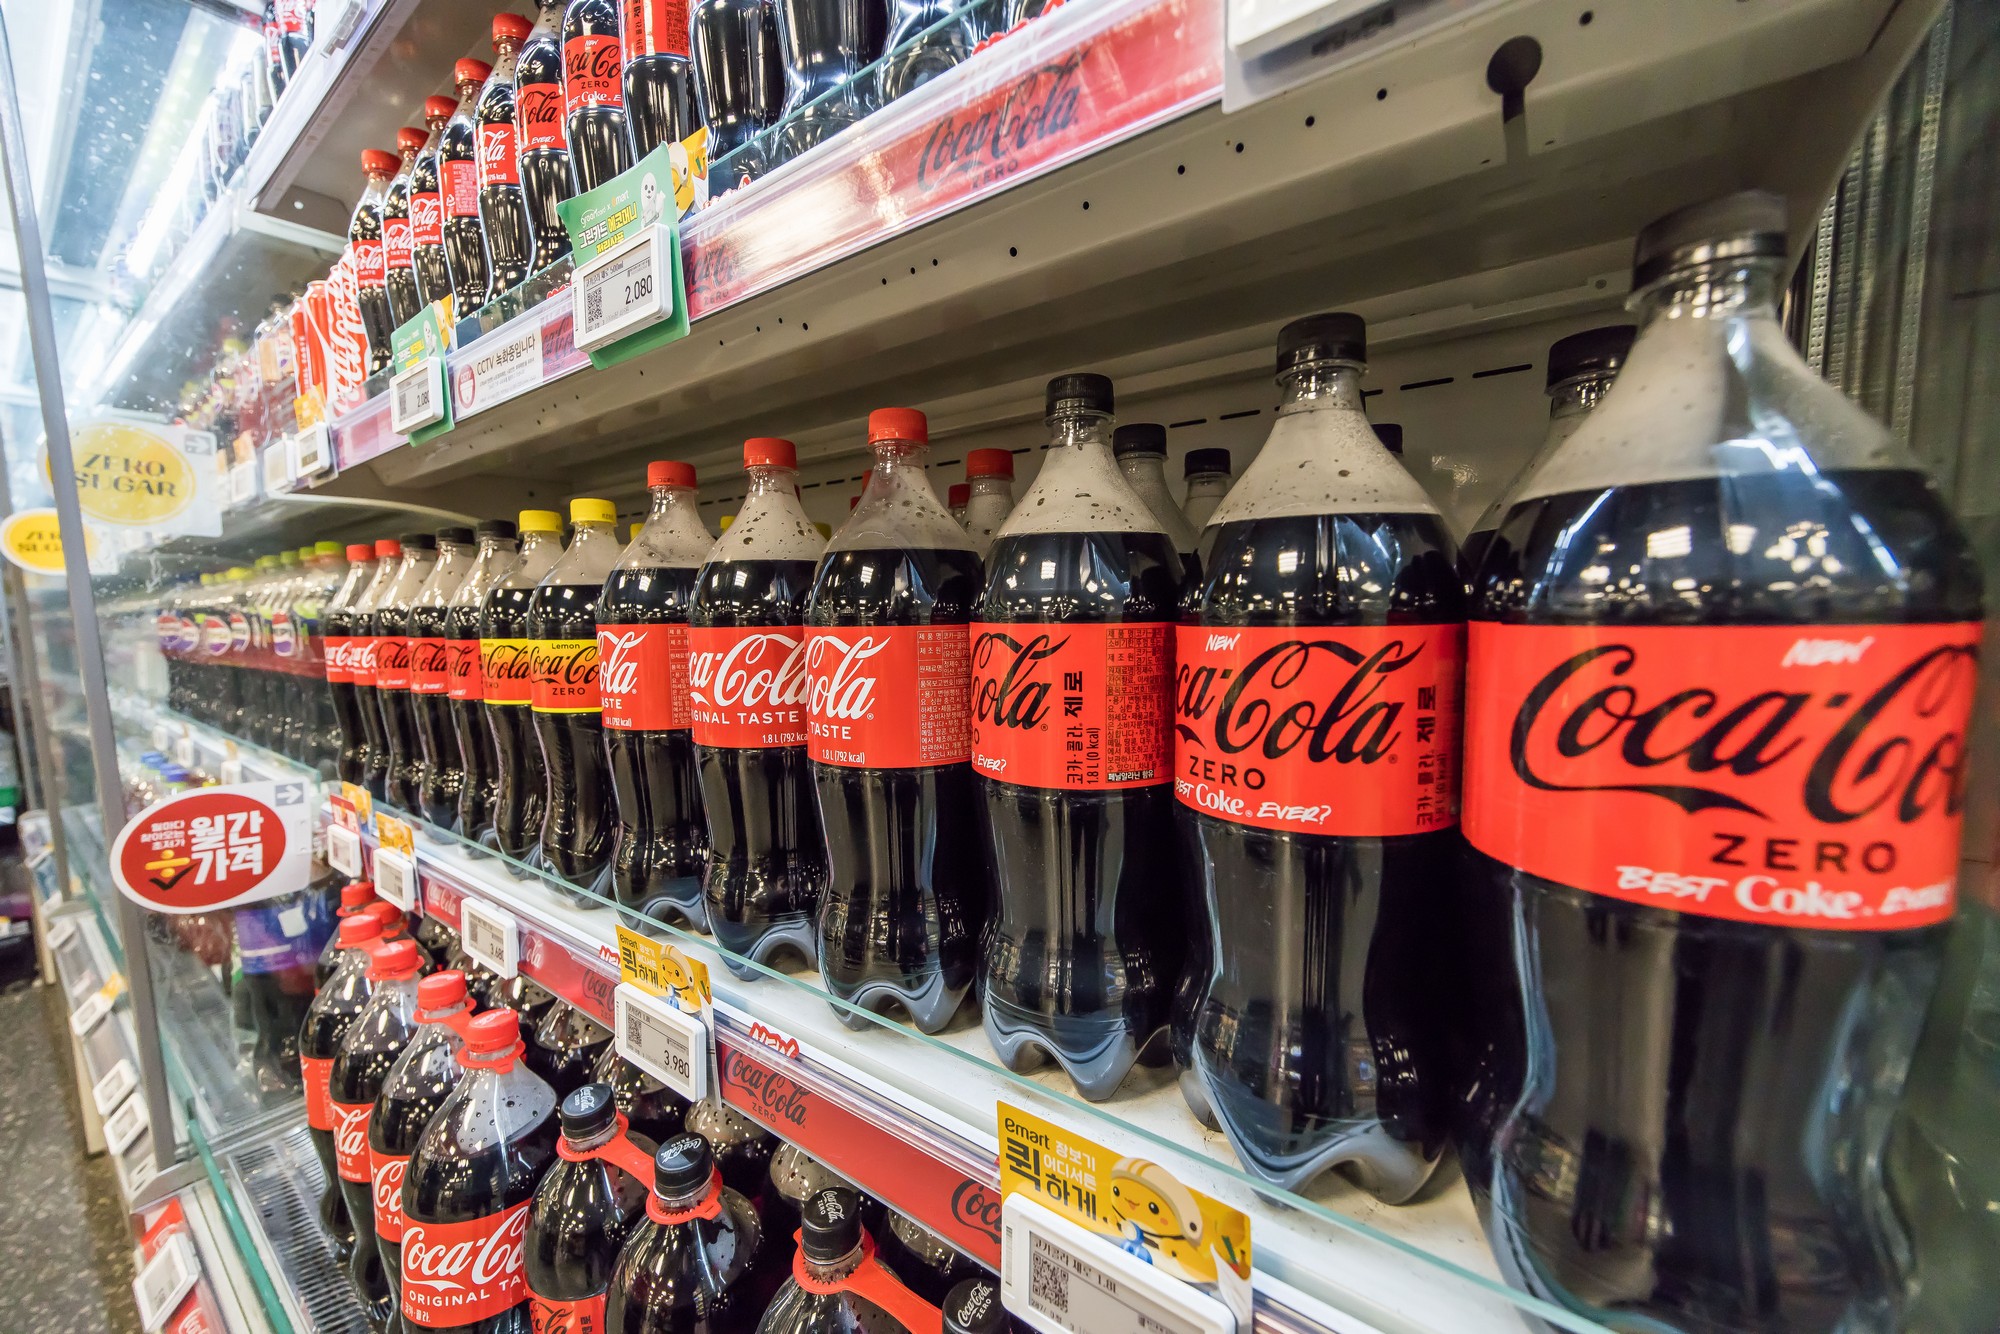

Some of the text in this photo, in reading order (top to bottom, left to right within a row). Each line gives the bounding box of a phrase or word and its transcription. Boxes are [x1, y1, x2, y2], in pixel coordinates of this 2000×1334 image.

[581, 81, 609, 90] ZERO
[970, 157, 1020, 188] ZERO
[476, 357, 494, 376] CCTV
[496, 334, 536, 366] 녹화중입니다
[83, 454, 166, 477] ZERO
[74, 471, 176, 497] SUGAR
[552, 642, 580, 650] Lemon
[1206, 633, 1241, 652] NEW
[552, 688, 586, 696] ZERO
[1064, 671, 1083, 718] 제로
[1176, 640, 1427, 764] ca-Cola
[737, 711, 799, 724] TASTE
[1417, 685, 1436, 743] 제로
[762, 734, 772, 744] 1.8
[774, 734, 778, 743] L
[780, 732, 795, 744] (792
[810, 722, 852, 740] TASTE
[1086, 728, 1100, 749] kcal)
[834, 750, 848, 762] (792
[848, 752, 865, 765] kcal)
[978, 754, 1006, 774] EVER?
[1087, 772, 1099, 784] 1.8
[1189, 756, 1266, 790] ZERO
[1196, 784, 1243, 816] Coke
[1256, 802, 1332, 826] EVER?
[188, 810, 264, 852] 월간
[191, 842, 264, 885] 가격
[1711, 832, 1897, 875] ZERO
[1616, 864, 1727, 902] BEST
[620, 934, 638, 950] emart
[724, 1048, 810, 1127] Coca-Cola
[752, 1102, 777, 1123] ZERO
[1004, 1117, 1050, 1150] emart
[1055, 1139, 1096, 1172] 장보기
[1044, 1156, 1097, 1192] 어디서든
[817, 1199, 826, 1215] ZERO
[822, 1190, 846, 1224] Coca-Cola
[409, 1288, 490, 1307] ORIGINAL
[957, 1282, 994, 1328] Coca-Cola
[976, 1298, 992, 1320] ZERO
